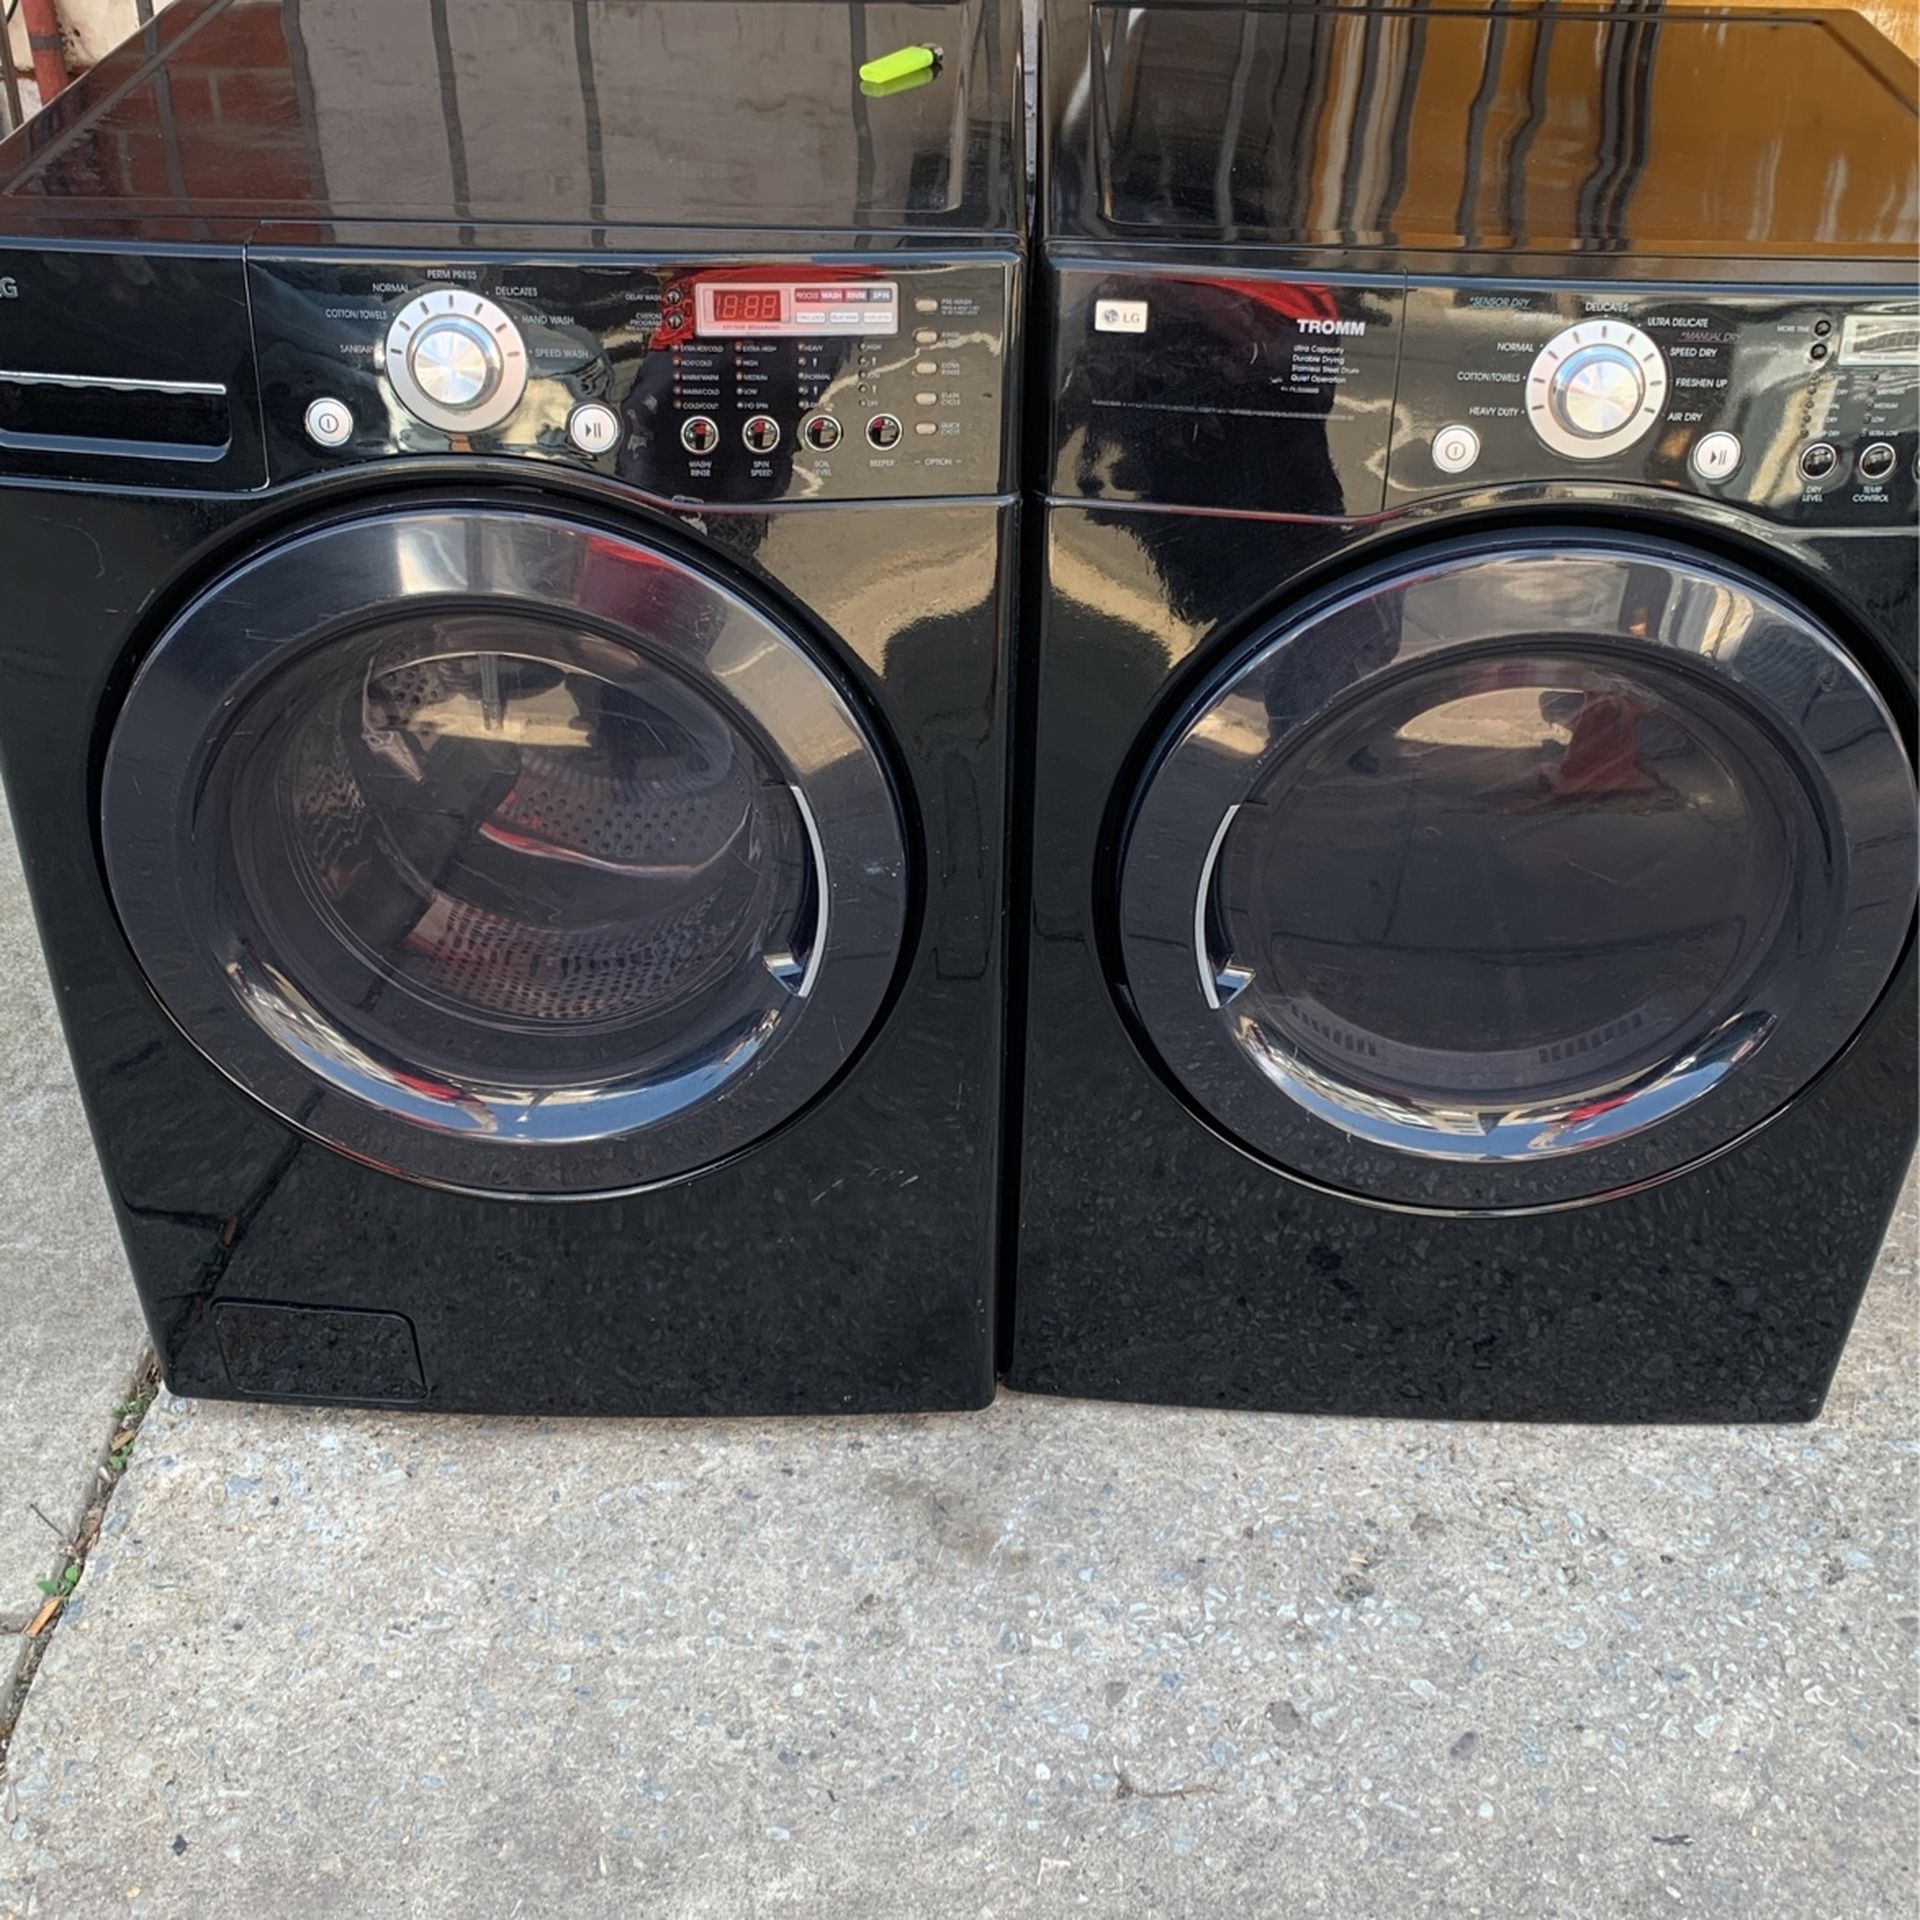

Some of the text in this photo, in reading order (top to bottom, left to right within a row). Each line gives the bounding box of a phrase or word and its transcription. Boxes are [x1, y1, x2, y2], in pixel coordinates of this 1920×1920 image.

[427, 269, 477, 280] PERM PRESS
[372, 283, 409, 293] NORMAL
[495, 287, 538, 297] DELICATES
[821, 290, 842, 299] WASH
[847, 290, 866, 299] RINSE
[873, 290, 890, 299] SPIN
[1509, 298, 1531, 308] DRY
[1585, 302, 1628, 313] DELICATES
[325, 309, 387, 320] COTTON/TOWELS
[1123, 312, 1140, 324] LG
[522, 315, 574, 325] HAND WASH
[1647, 317, 1709, 328] ULTRA DELICATE
[1296, 318, 1366, 336] TROMM
[1721, 333, 1743, 342] DRY
[1311, 345, 1344, 354] Capacity
[1497, 342, 1534, 352] NORMAL
[535, 348, 588, 359] SPEED WASH
[1669, 347, 1717, 358] SPEED DRY
[1292, 354, 1345, 365] Durable Drying
[1291, 364, 1320, 372] Stainless
[1291, 374, 1346, 383] Quiet Operation
[1457, 371, 1521, 383] COTTON/TOWELS
[1675, 377, 1728, 388] FRESHEN UP
[1469, 407, 1520, 417] HEAVY DUTY
[1667, 412, 1702, 422] AIR DRY
[753, 460, 770, 468] SPIN
[869, 459, 895, 467] BEEPER
[924, 457, 952, 466] OPTION
[690, 469, 711, 477] RINSE
[750, 469, 773, 477] SPEED
[1802, 494, 1823, 502] LEVEL
[1852, 494, 1889, 502] CONTROL
